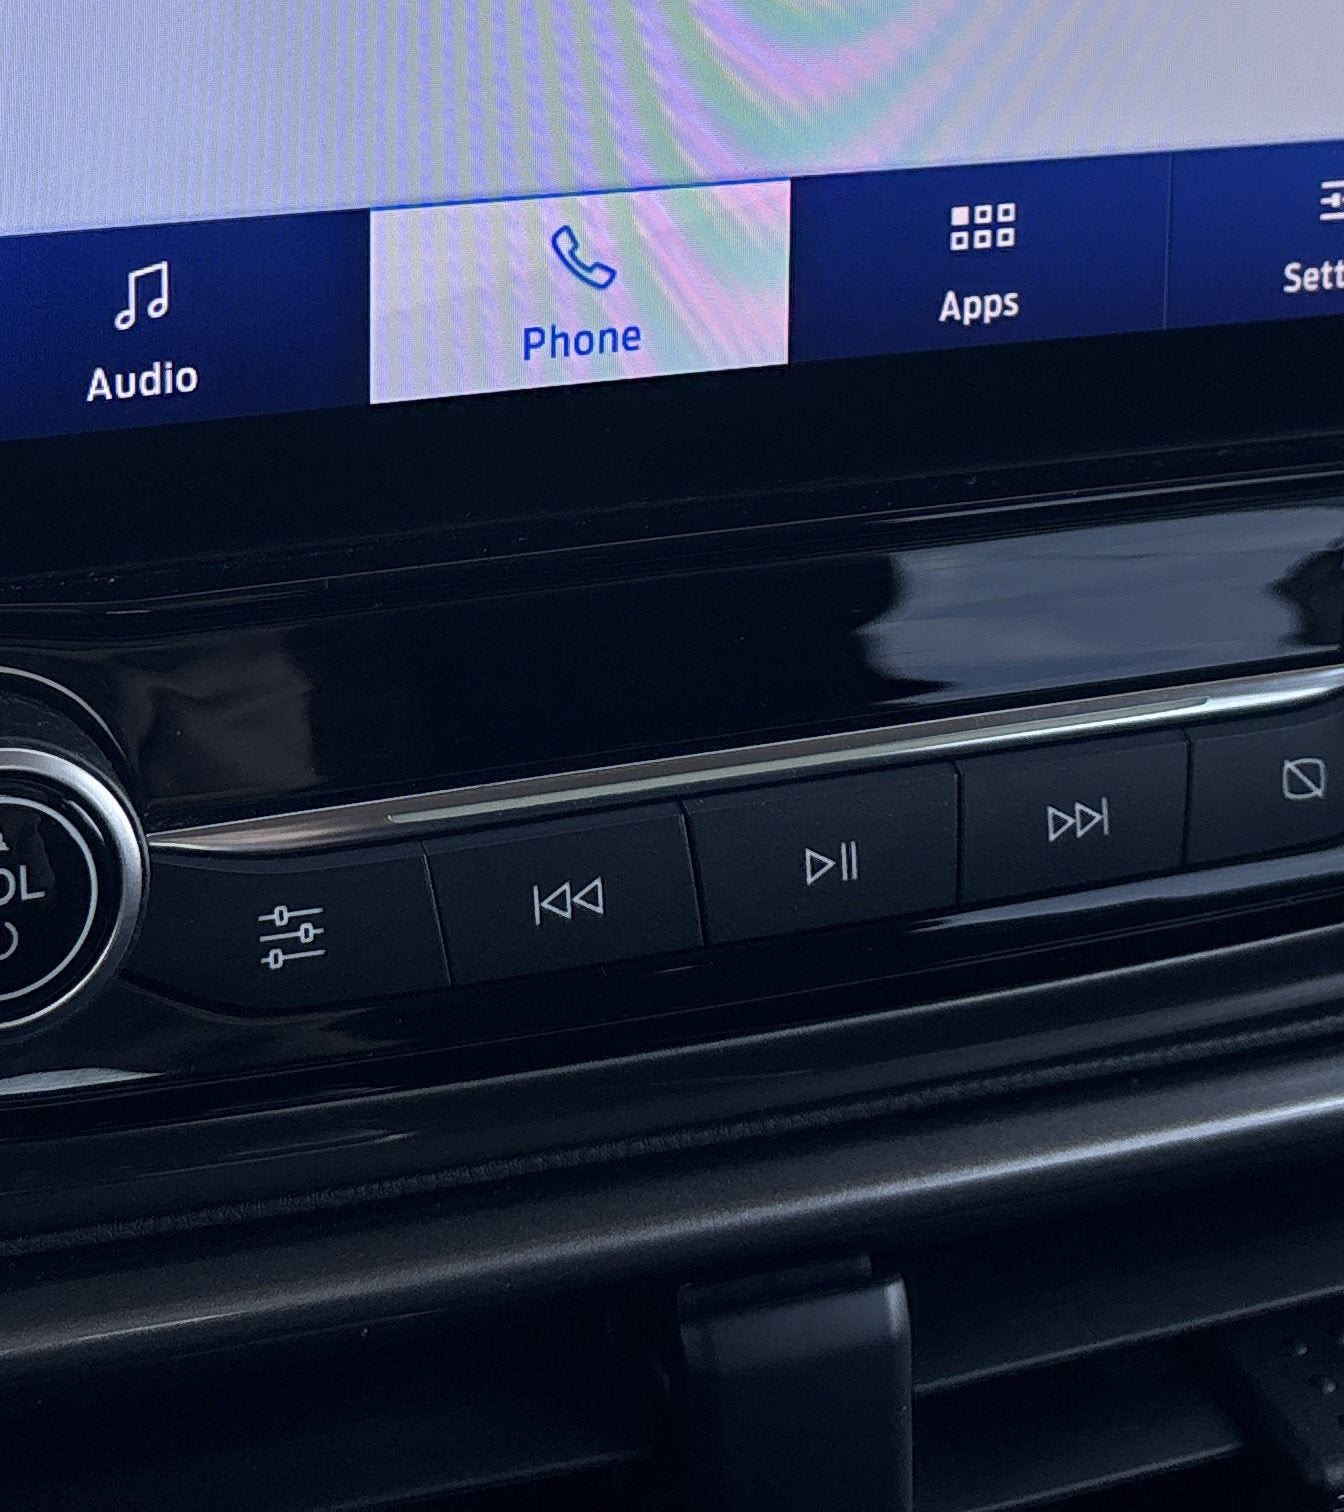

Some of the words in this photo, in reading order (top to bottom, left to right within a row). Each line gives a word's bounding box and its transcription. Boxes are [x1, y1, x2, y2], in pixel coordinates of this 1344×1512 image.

[938, 290, 1020, 326] Apps
[522, 324, 643, 361] Phone
[85, 361, 199, 402] Audio
